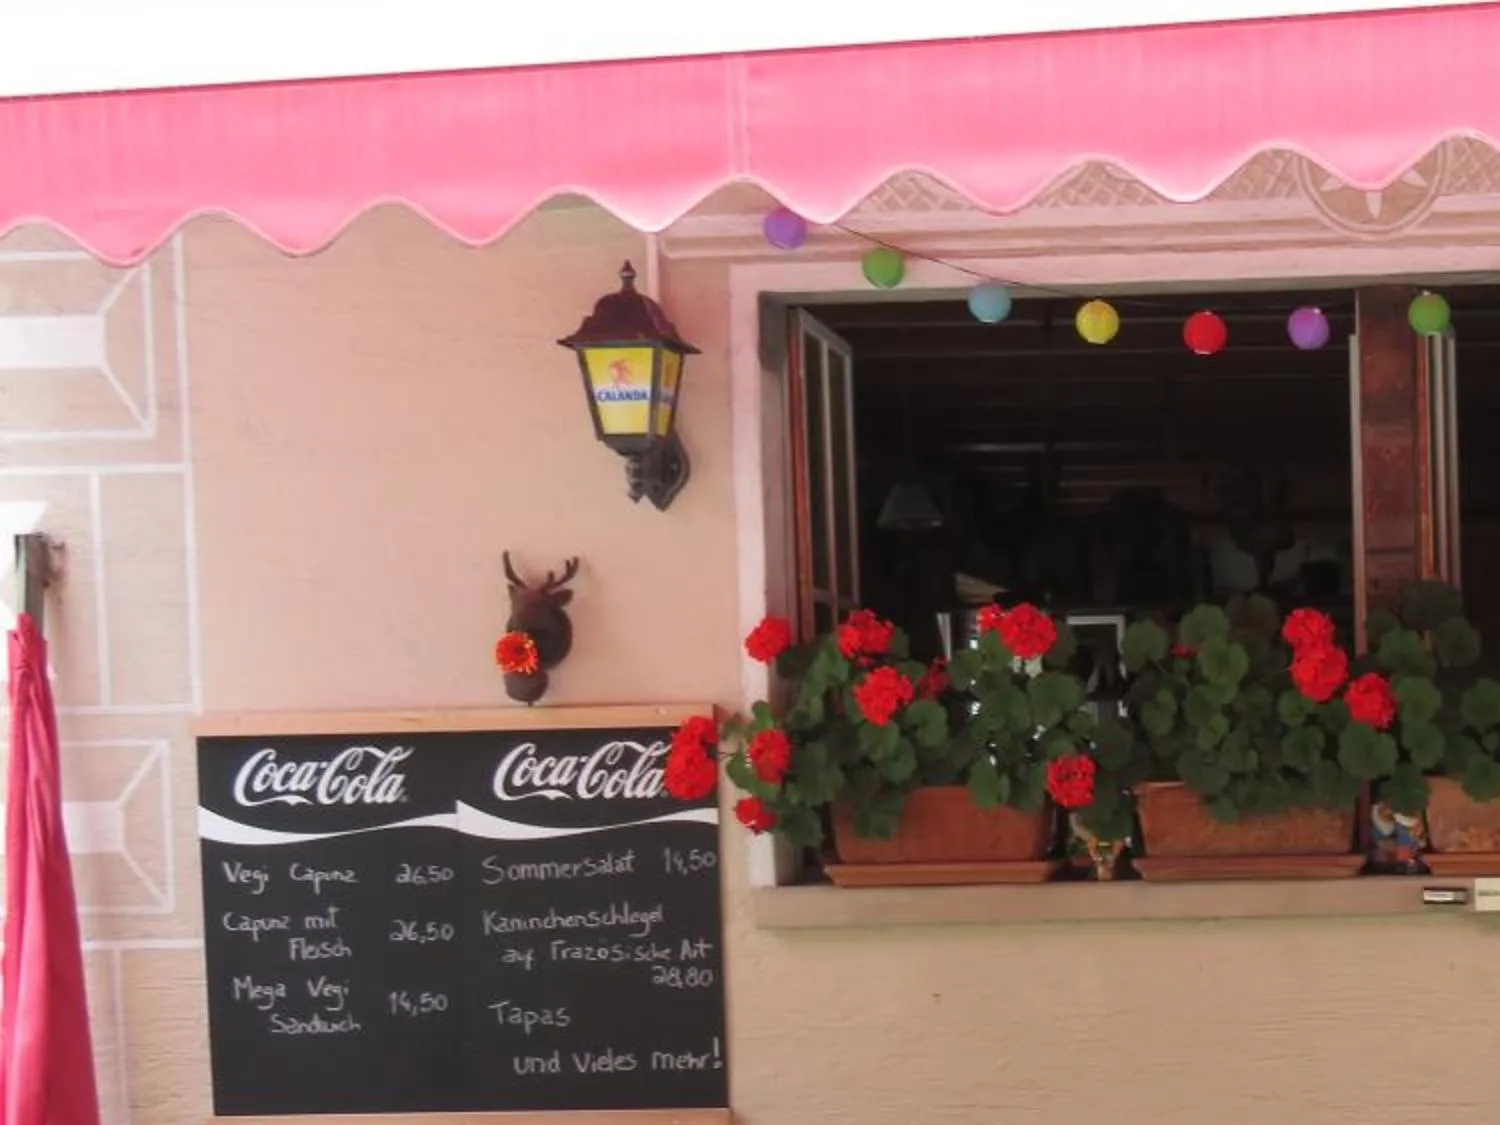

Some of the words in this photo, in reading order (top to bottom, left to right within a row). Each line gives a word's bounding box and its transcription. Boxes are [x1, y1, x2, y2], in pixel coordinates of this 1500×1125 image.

[598, 389, 648, 401] CALANDA
[222, 860, 270, 895] Vegi
[480, 849, 637, 885] Sommersalat
[304, 905, 339, 929] mit
[501, 947, 535, 971] auf
[232, 975, 287, 1010] Mega
[306, 975, 350, 1011] Vegi
[488, 1001, 571, 1034] Tapas
[513, 1050, 562, 1075] und
[573, 1047, 638, 1073] Vieles
[651, 1037, 723, 1070] mehr!
